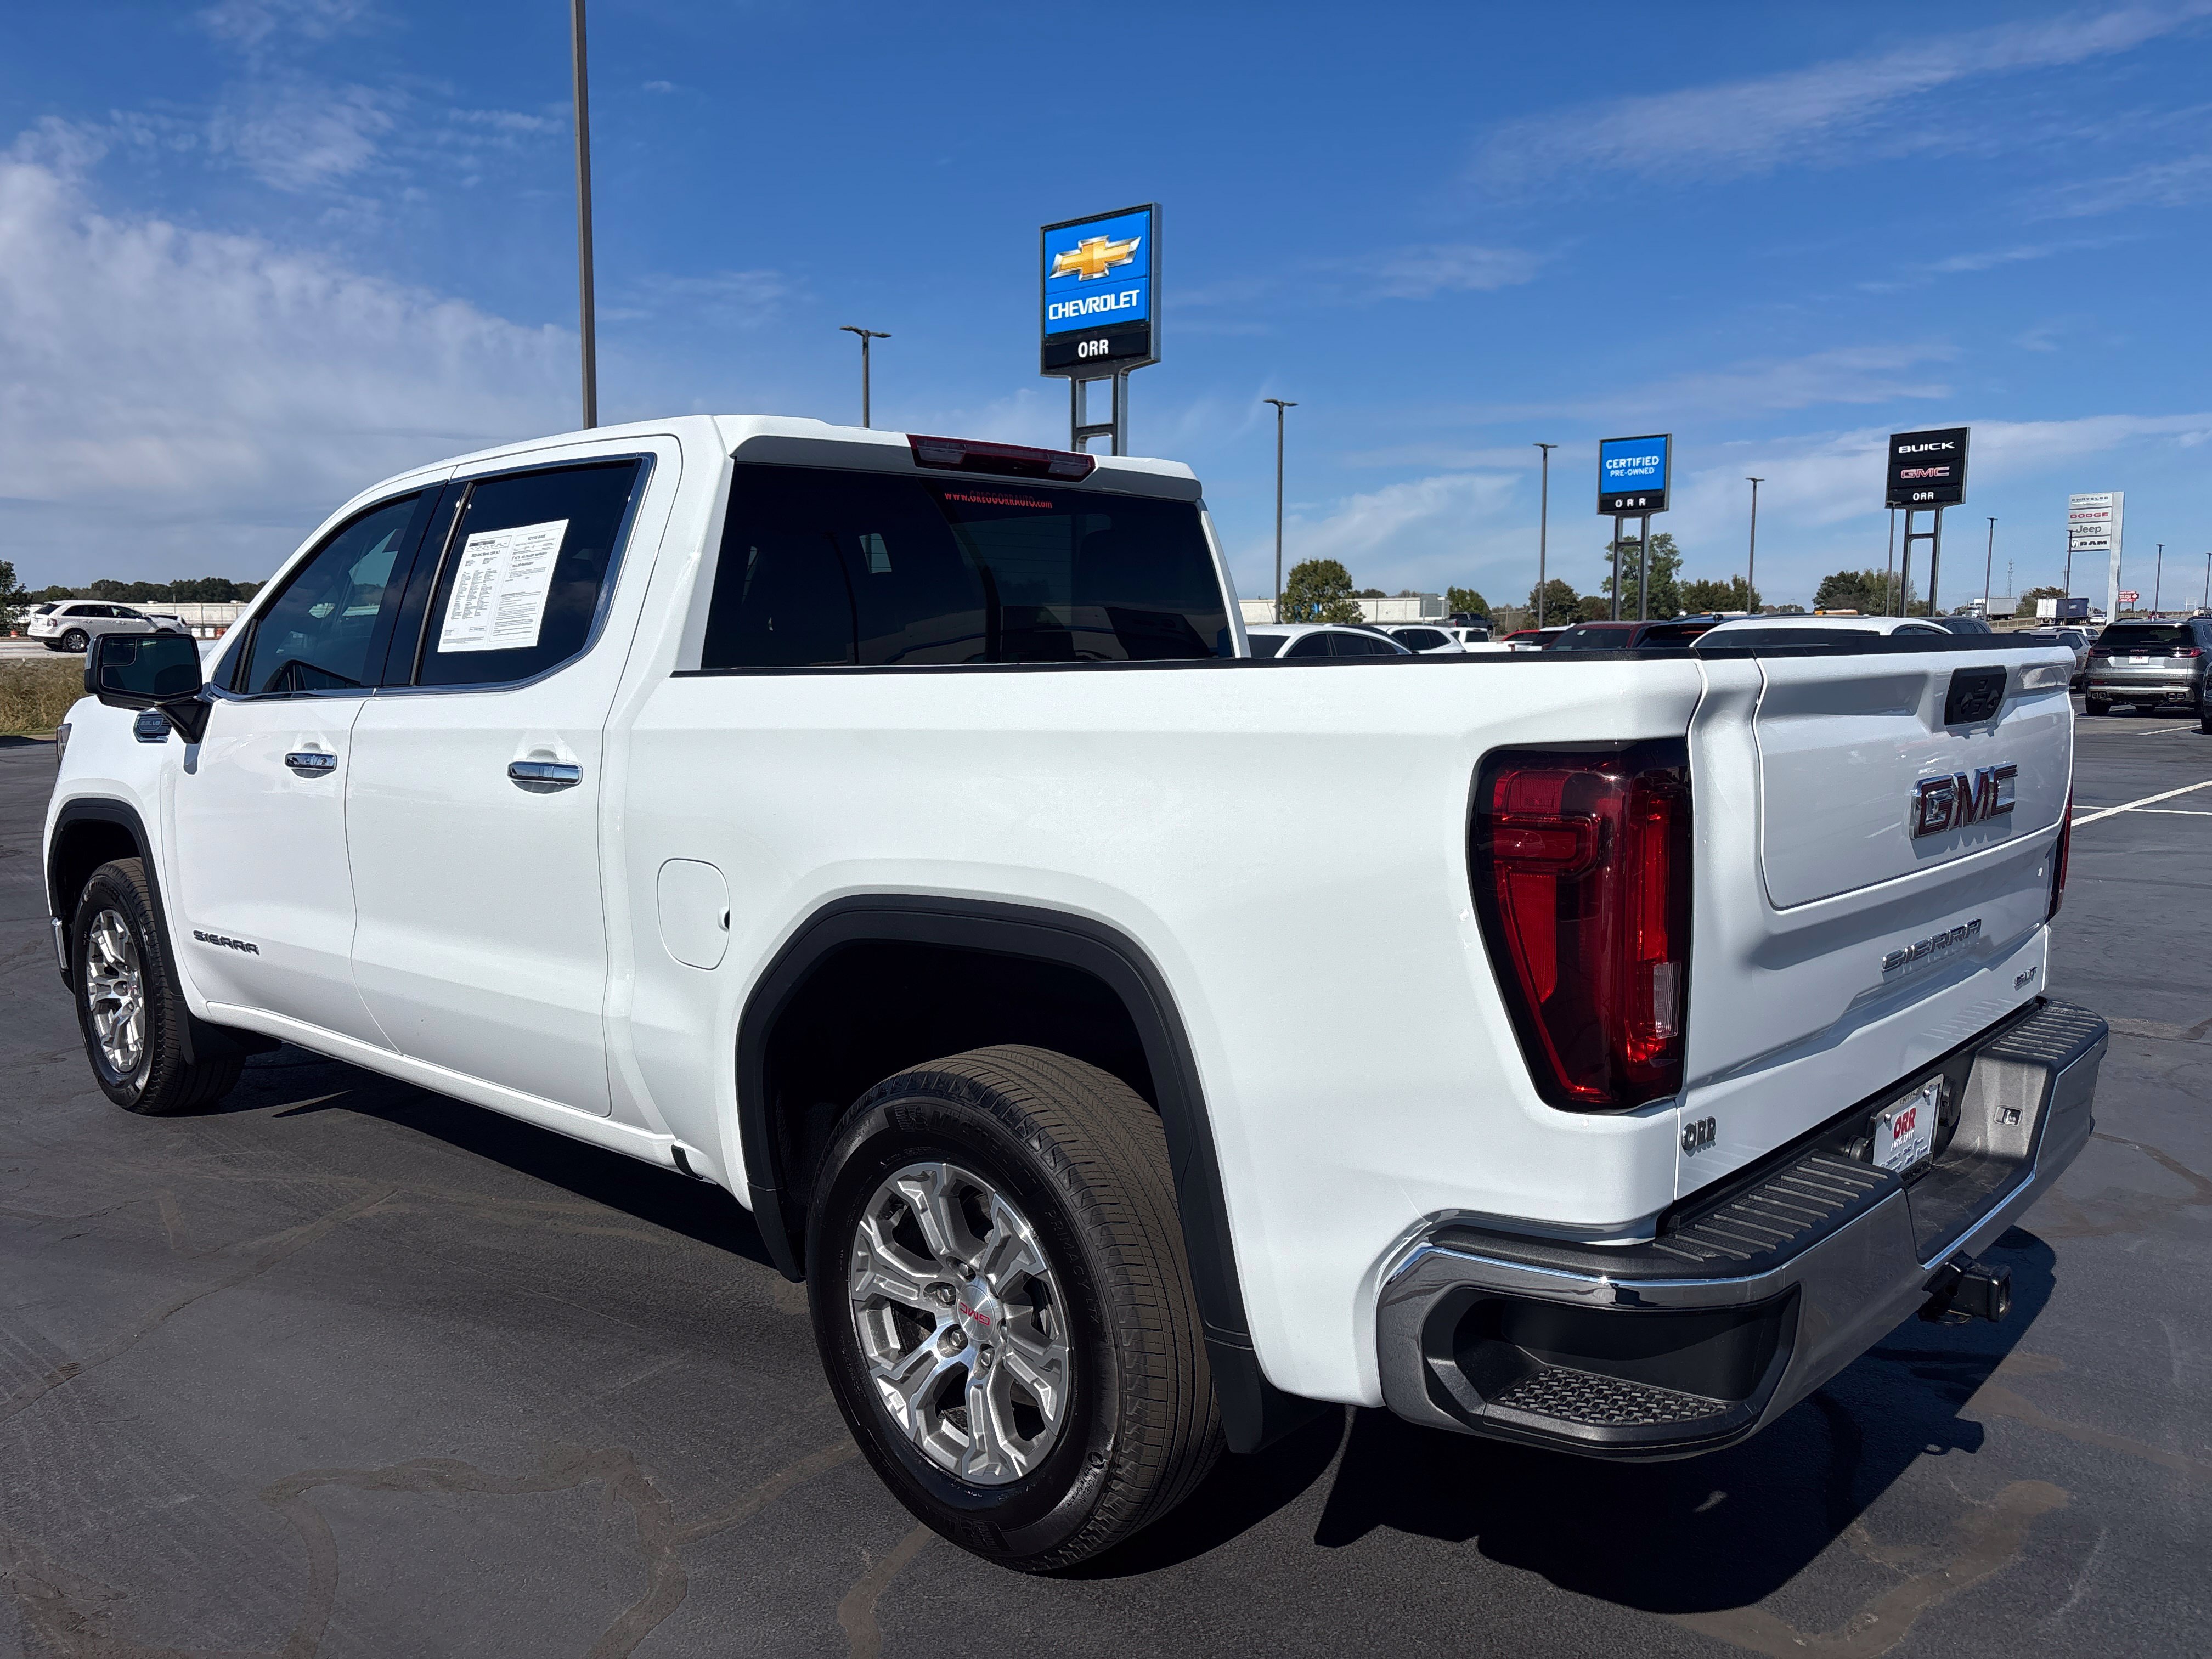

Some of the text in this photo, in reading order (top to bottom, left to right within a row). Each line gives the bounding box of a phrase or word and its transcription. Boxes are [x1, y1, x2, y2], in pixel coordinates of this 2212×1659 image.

[1048, 289, 1140, 320] CHEVROLET
[1078, 339, 1109, 358] ORR
[1898, 441, 1955, 453] BUICK
[1606, 455, 1660, 469] CERTIFIED
[1610, 467, 1655, 477] PRE-OWNED
[1900, 466, 1950, 479] GMC
[1912, 492, 1934, 501] ORR
[2075, 525, 2102, 534] Jeep
[1909, 761, 2018, 839] GMC
[193, 930, 260, 956] SIERRA
[1882, 918, 1982, 973] SIERRA
[1681, 1116, 1716, 1151] ORR
[1894, 1107, 1917, 1139] ORR
[1045, 1209, 1091, 1290] PRIMACY
[960, 1301, 990, 1326] GMC
[1079, 1470, 1098, 1504] MICHELIN
